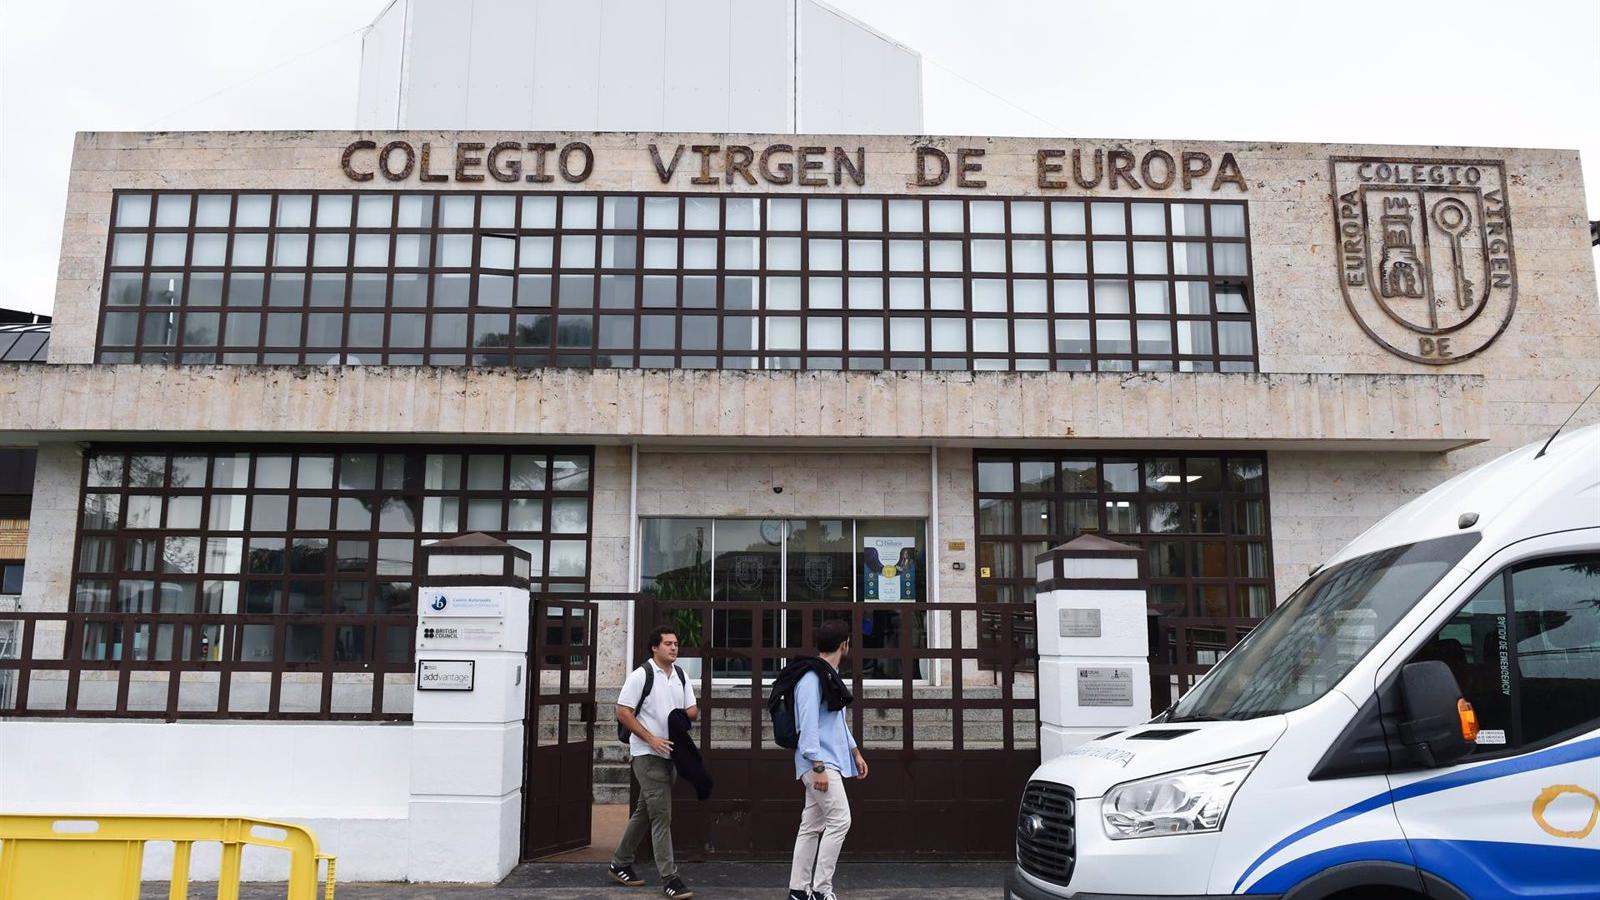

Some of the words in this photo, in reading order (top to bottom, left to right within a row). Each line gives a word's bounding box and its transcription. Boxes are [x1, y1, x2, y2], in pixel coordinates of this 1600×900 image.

[341, 140, 594, 183] COLEGIO
[648, 143, 865, 187] VIRGEN
[915, 146, 987, 188] DE
[1037, 148, 1249, 192] EUROPA
[1358, 162, 1481, 185] COLEGIO
[1340, 190, 1365, 287] EUROPA
[1484, 188, 1511, 289] VIRGEN
[1418, 336, 1453, 357] DE
[423, 673, 469, 682] addvantage
